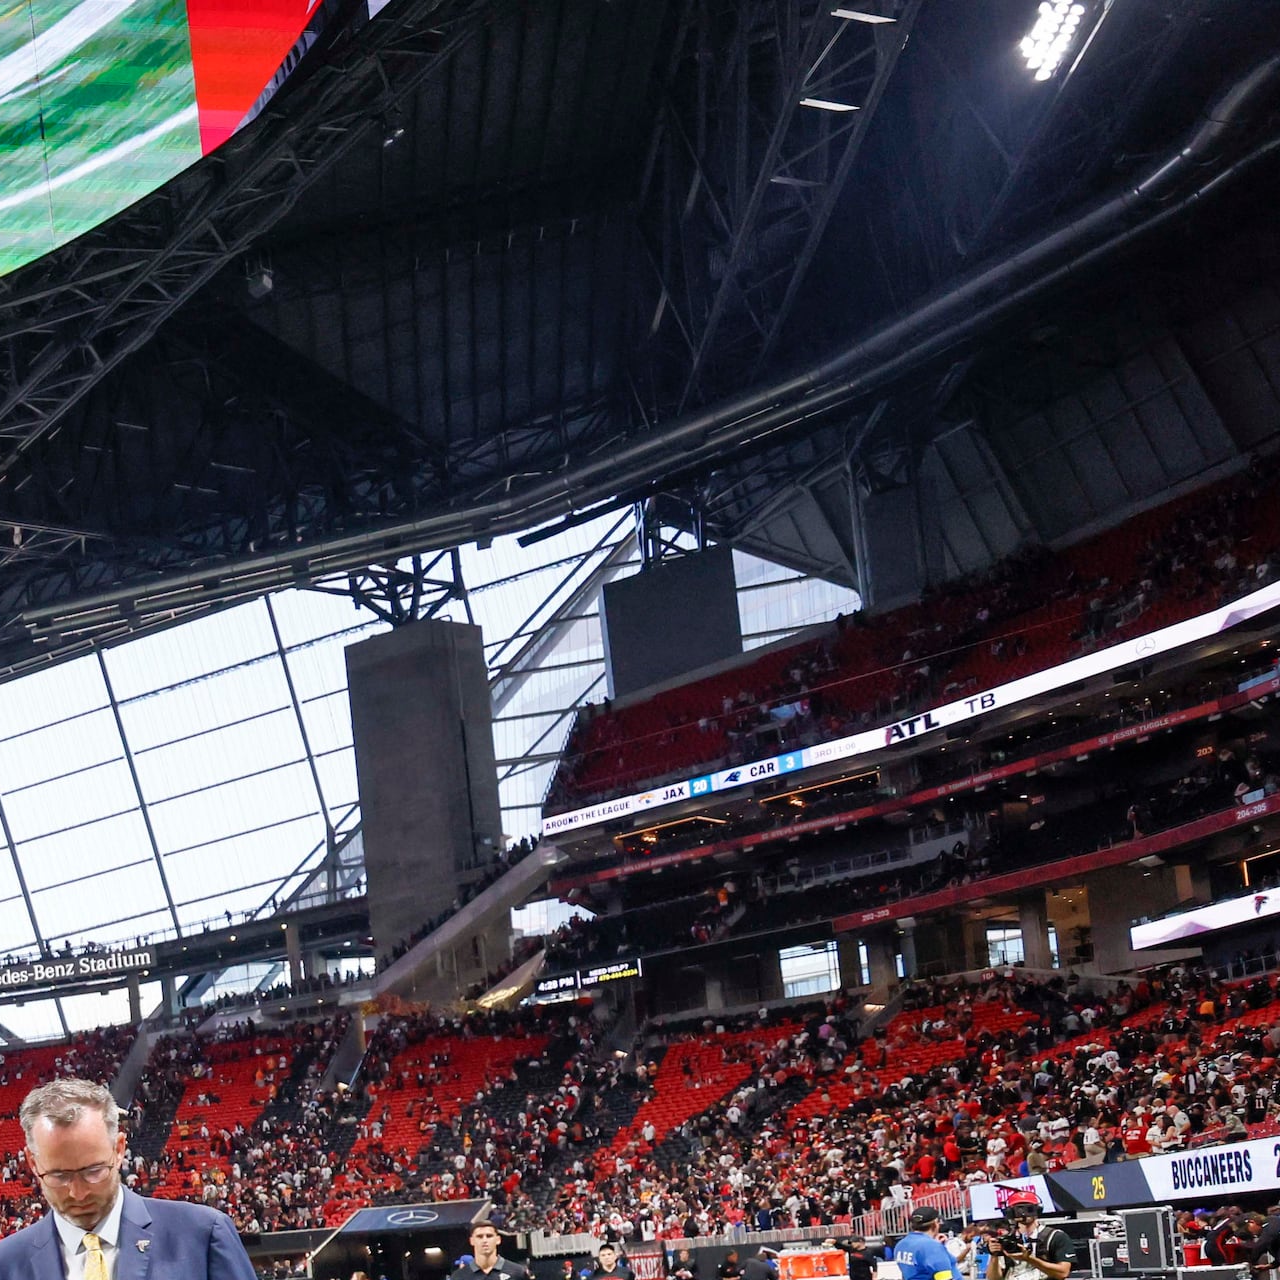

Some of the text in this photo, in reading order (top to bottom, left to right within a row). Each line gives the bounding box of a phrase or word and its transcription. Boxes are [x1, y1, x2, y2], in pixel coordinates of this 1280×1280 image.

[885, 693, 996, 745] ATL TB
[1112, 727, 1137, 741] JESSIE
[1139, 718, 1169, 731] TUGGLE
[750, 762, 775, 777] CAR
[786, 756, 794, 768] 3
[663, 786, 685, 800] JAX
[693, 779, 708, 794] 20
[546, 801, 631, 830] AROUND THE LEAGUE
[1237, 803, 1266, 819] 204-205
[80, 951, 151, 973] Stadium
[559, 977, 574, 988] PM
[1172, 1150, 1252, 1190] BUCCANEERS
[1092, 1177, 1105, 1199] 25
